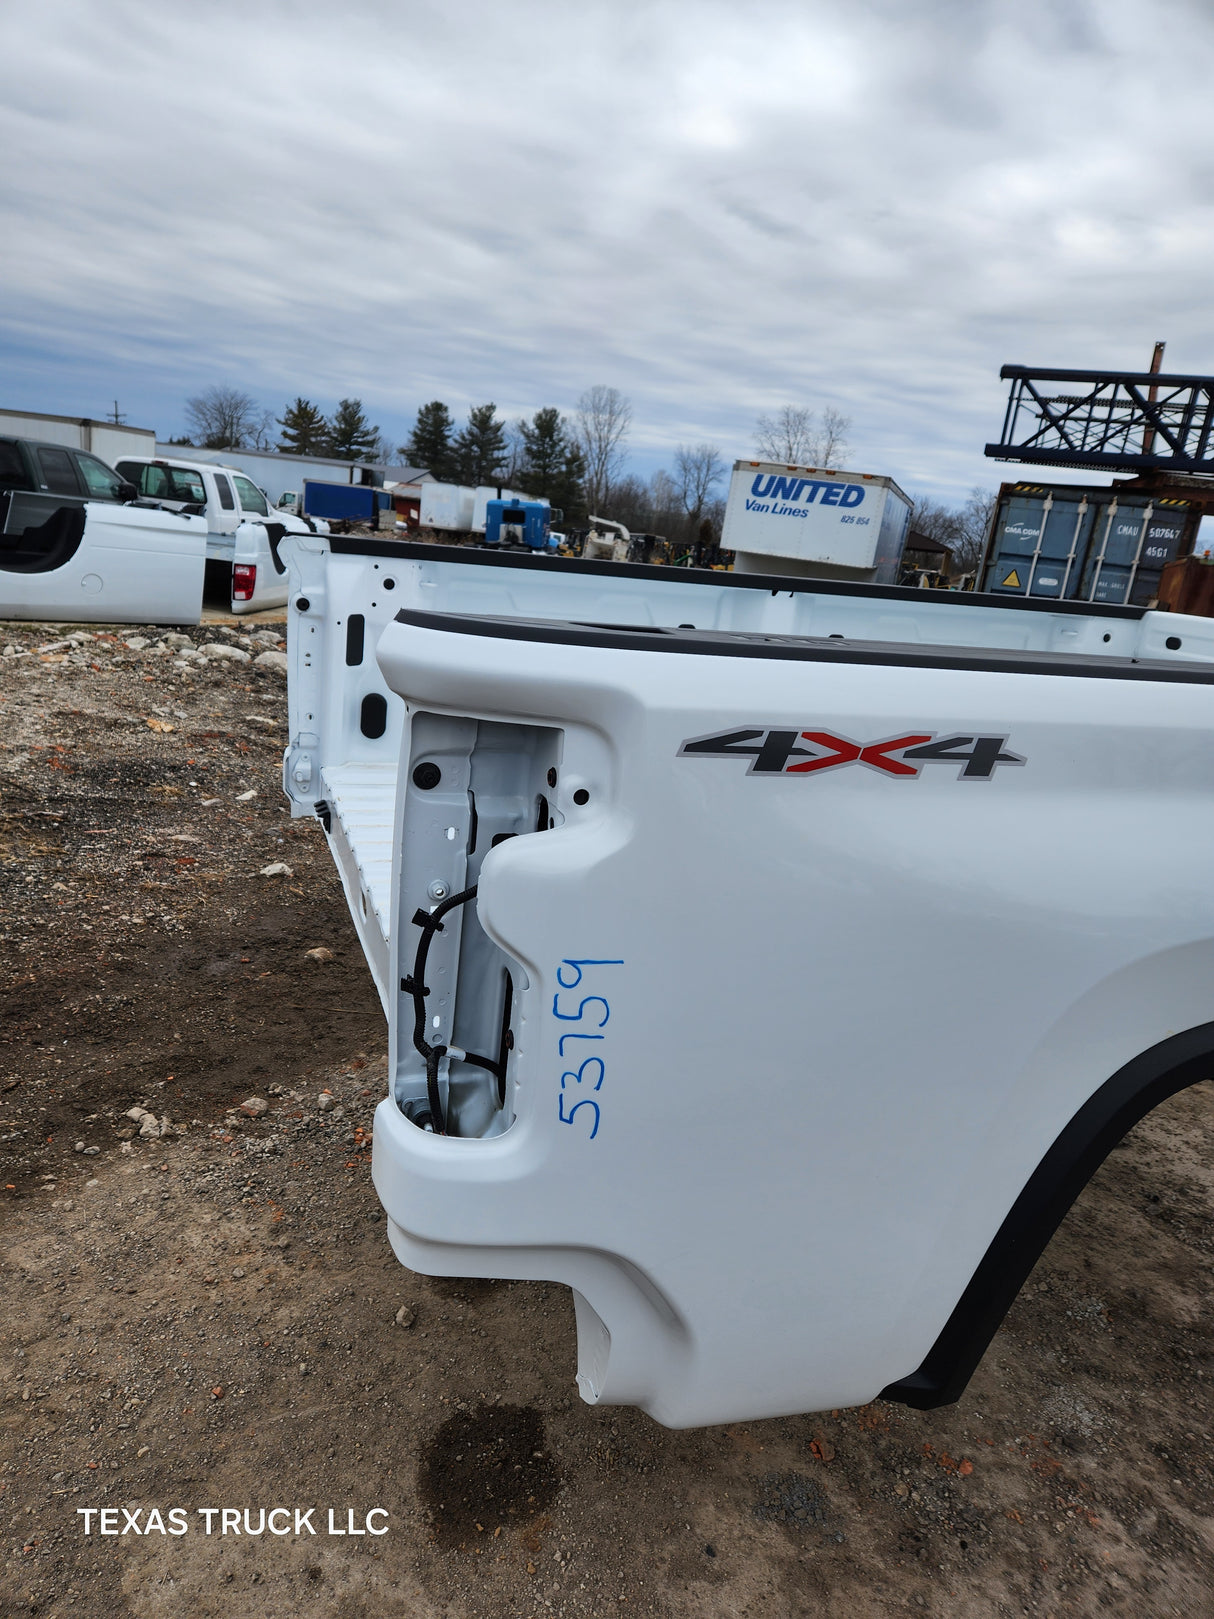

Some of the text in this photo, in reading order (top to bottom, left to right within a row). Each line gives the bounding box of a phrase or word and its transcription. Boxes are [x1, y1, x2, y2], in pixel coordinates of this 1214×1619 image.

[751, 474, 865, 508] UNITED
[745, 499, 809, 518] Van Lines
[1004, 526, 1022, 535] CMA
[552, 959, 624, 1140] 53759
